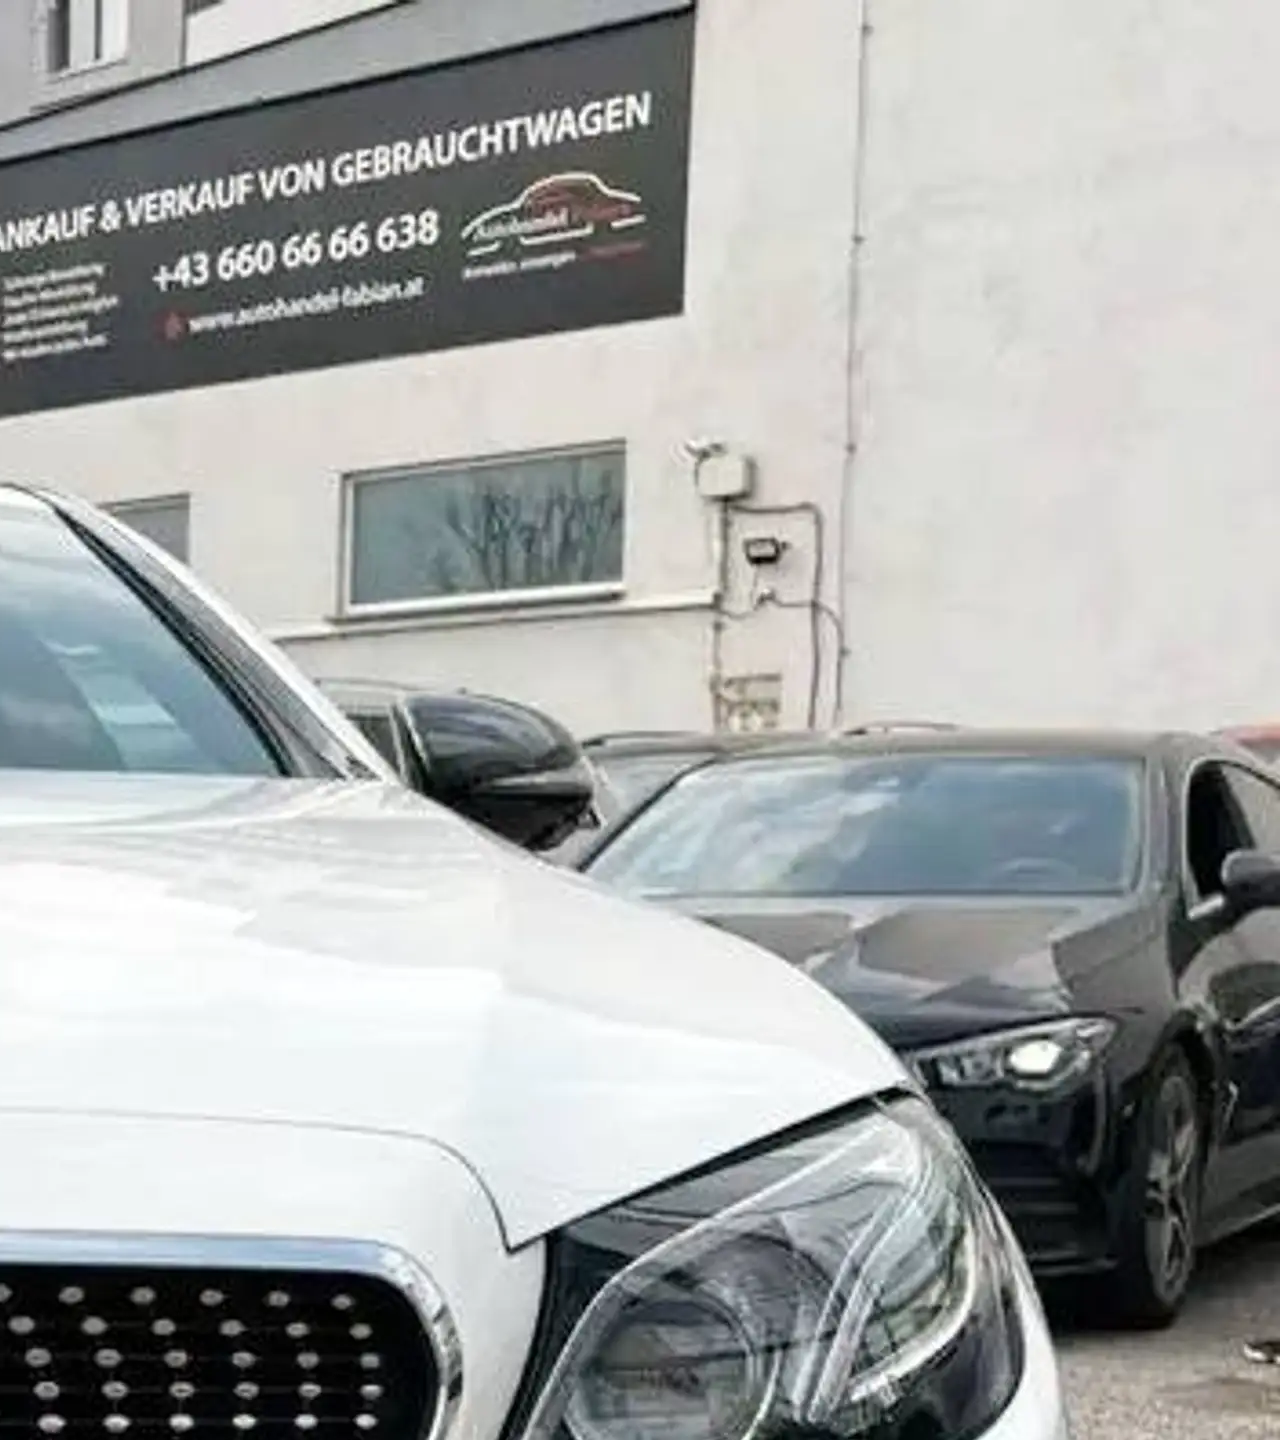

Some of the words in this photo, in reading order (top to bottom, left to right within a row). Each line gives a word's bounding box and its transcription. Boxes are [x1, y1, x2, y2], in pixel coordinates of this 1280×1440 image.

[98, 200, 122, 233] &
[124, 171, 254, 228] VERKAUF
[257, 158, 326, 201] VON
[331, 91, 653, 187] GEBRAUCHTWAGEN
[152, 251, 210, 293] +43
[217, 239, 276, 282] 660
[281, 229, 324, 268] 66
[329, 219, 371, 261] 66
[376, 208, 439, 253] 638
